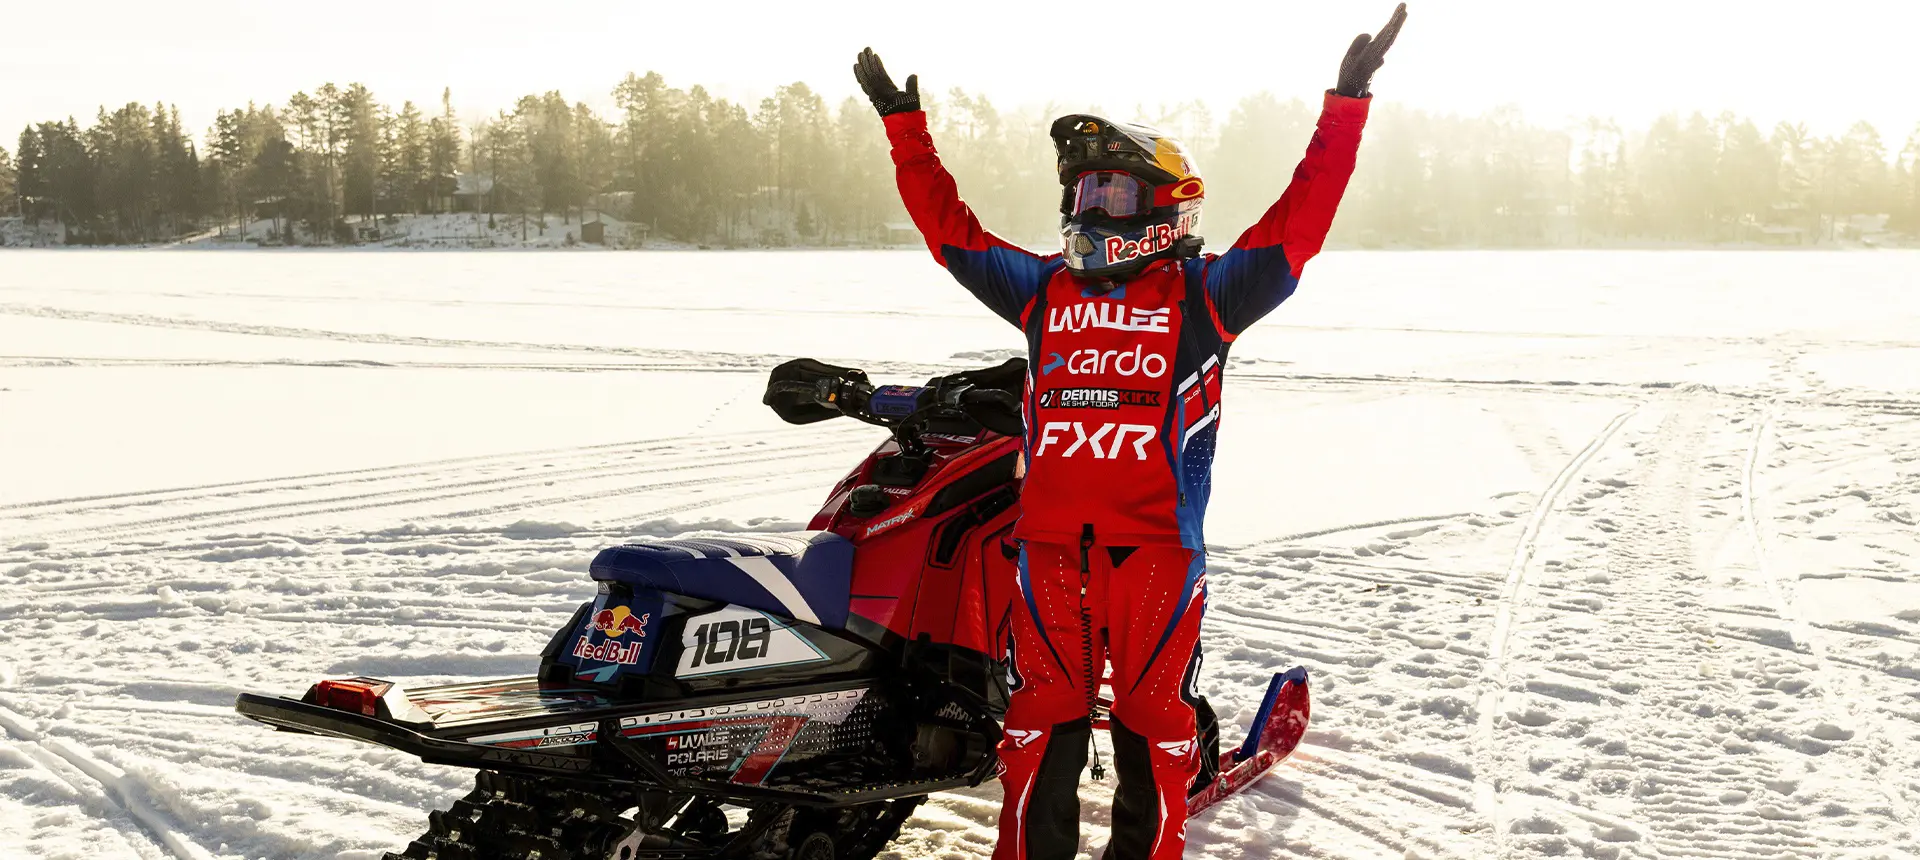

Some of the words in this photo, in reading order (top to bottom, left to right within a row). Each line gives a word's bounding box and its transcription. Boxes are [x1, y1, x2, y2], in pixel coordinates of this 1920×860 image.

[1105, 225, 1154, 265] Red
[1155, 215, 1190, 251] Bull
[1048, 302, 1170, 333] LAVALLEE
[1067, 344, 1167, 378] cardo
[1036, 421, 1157, 460] FXR
[573, 635, 610, 661] Red
[604, 641, 642, 664] Bull
[690, 618, 772, 668] 108
[668, 749, 728, 765] POLARIS
